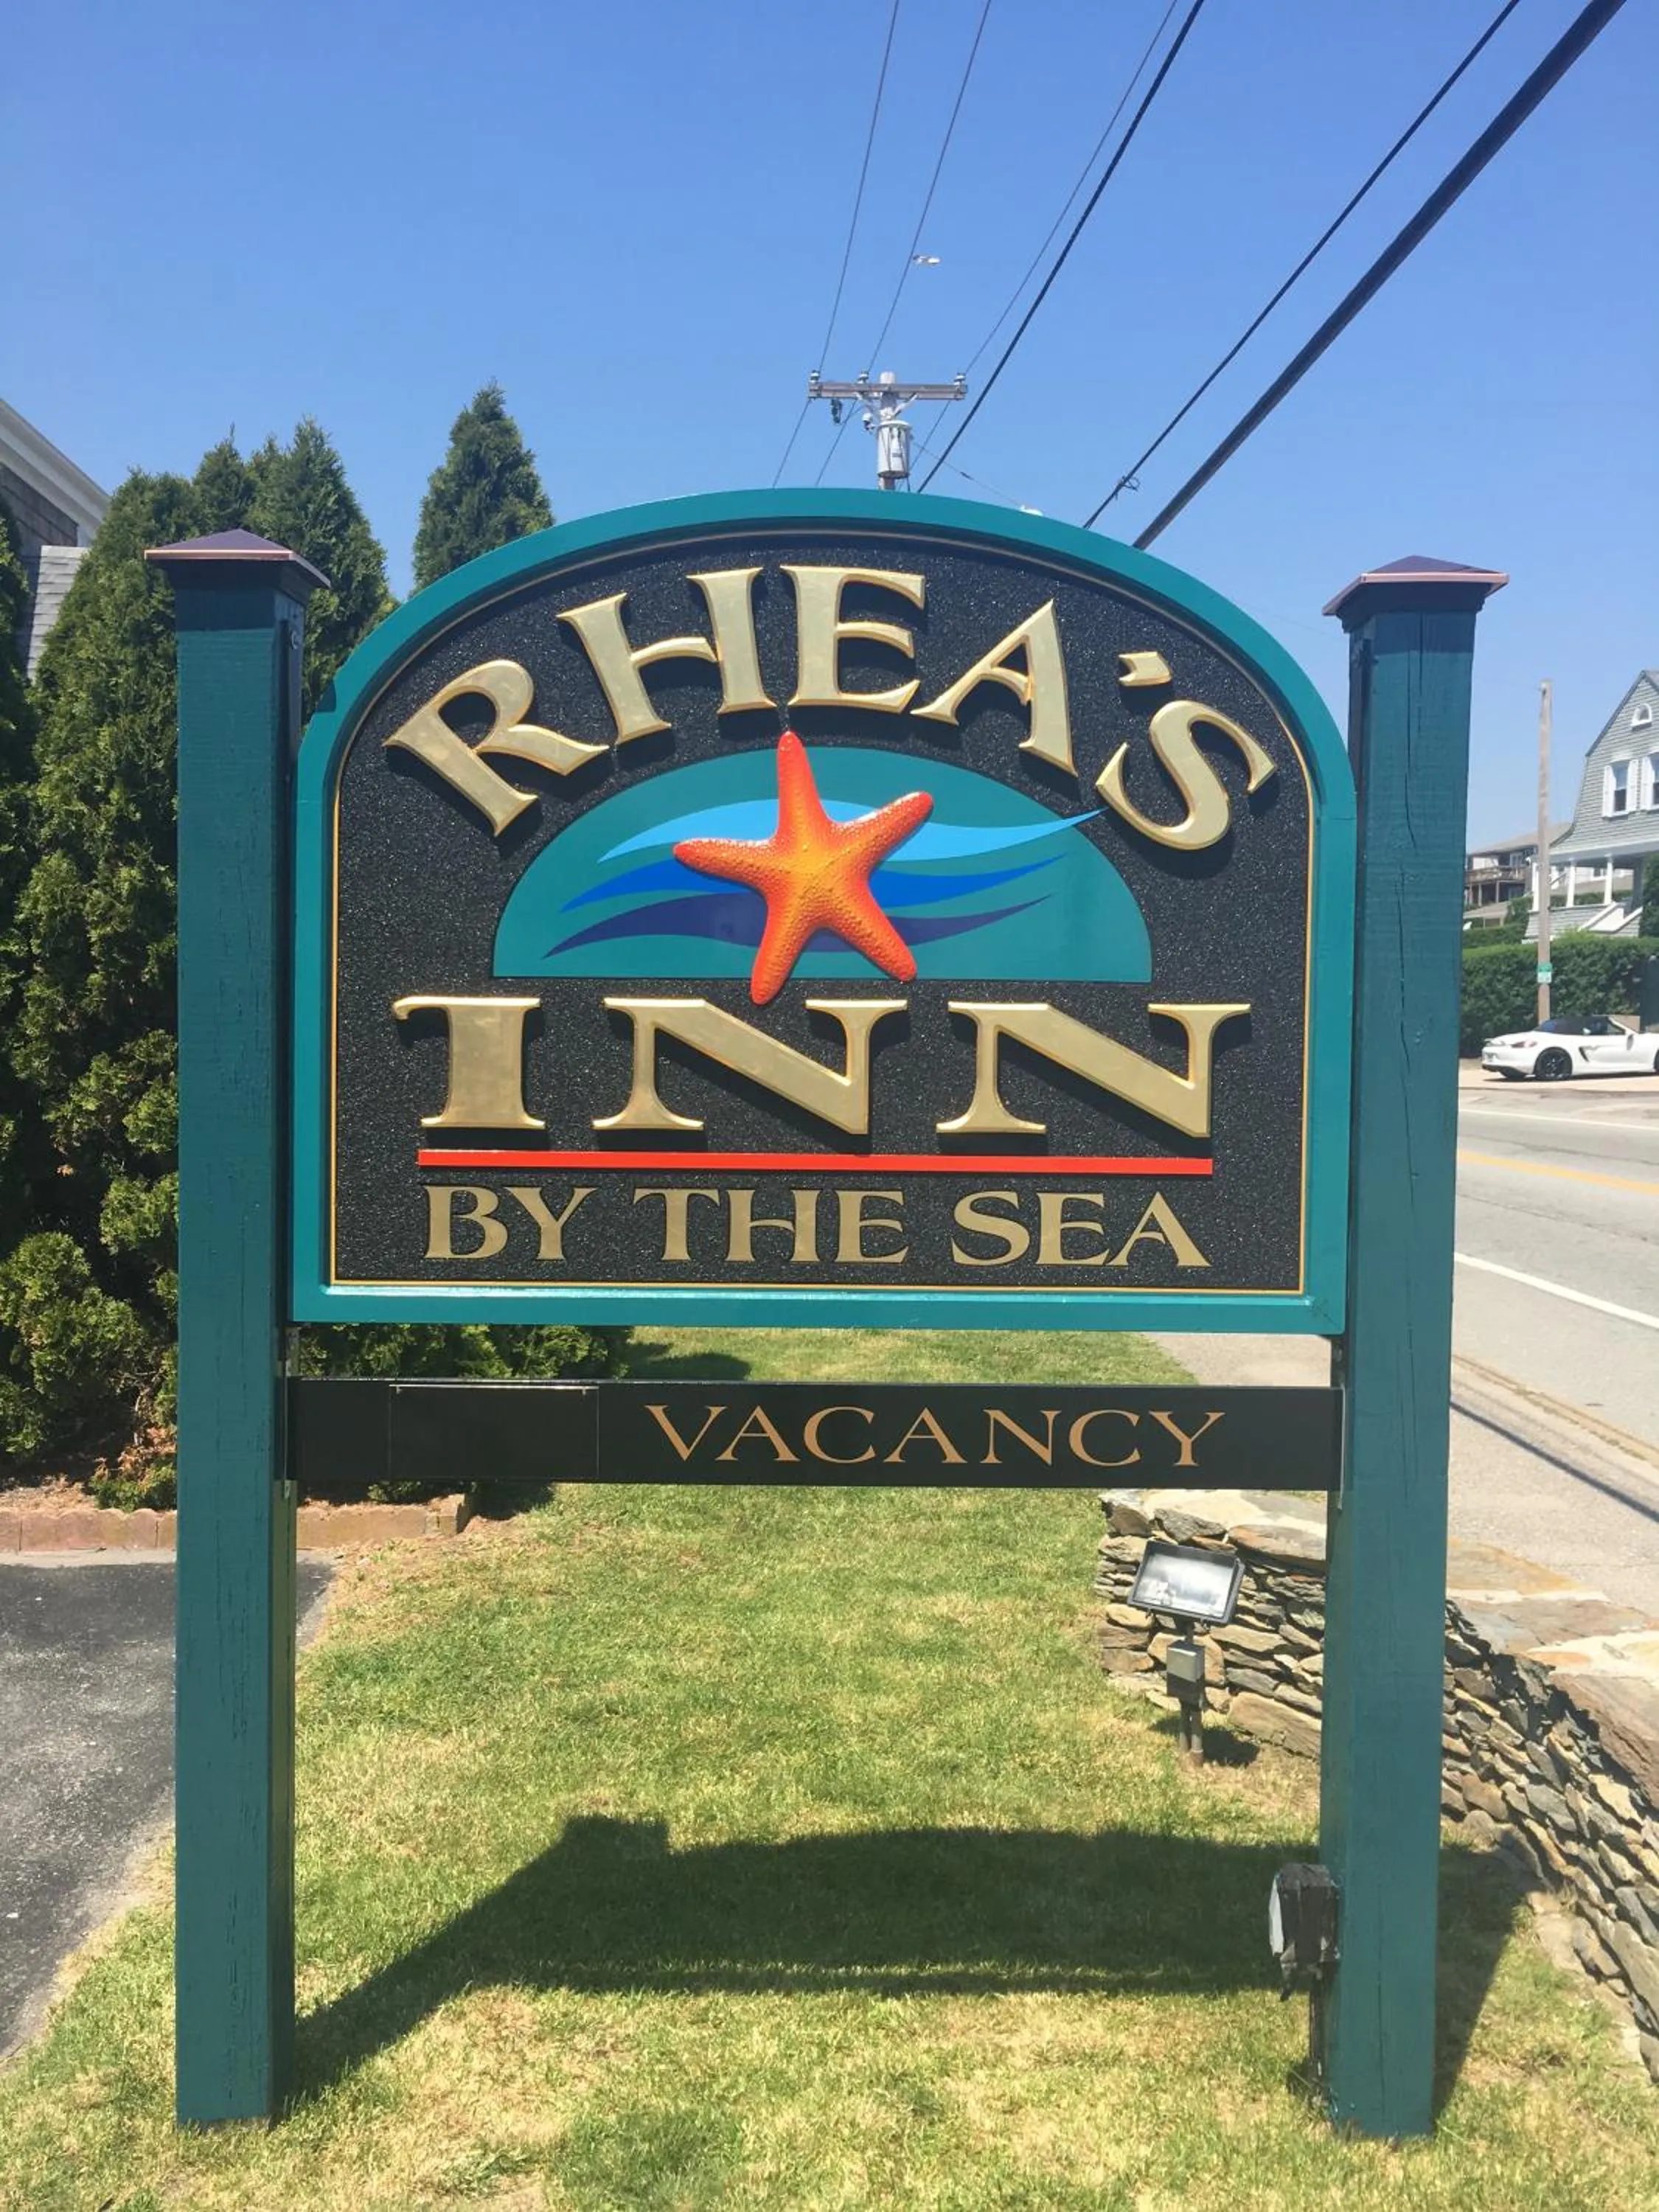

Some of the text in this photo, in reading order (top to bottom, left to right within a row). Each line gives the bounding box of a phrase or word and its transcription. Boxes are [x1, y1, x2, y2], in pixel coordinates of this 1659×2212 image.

[383, 565, 1276, 850] RHEA'S
[392, 995, 1252, 1138] INN
[422, 1184, 1213, 1269] BY THE SEA
[645, 1404, 1225, 1468] VACANCY
